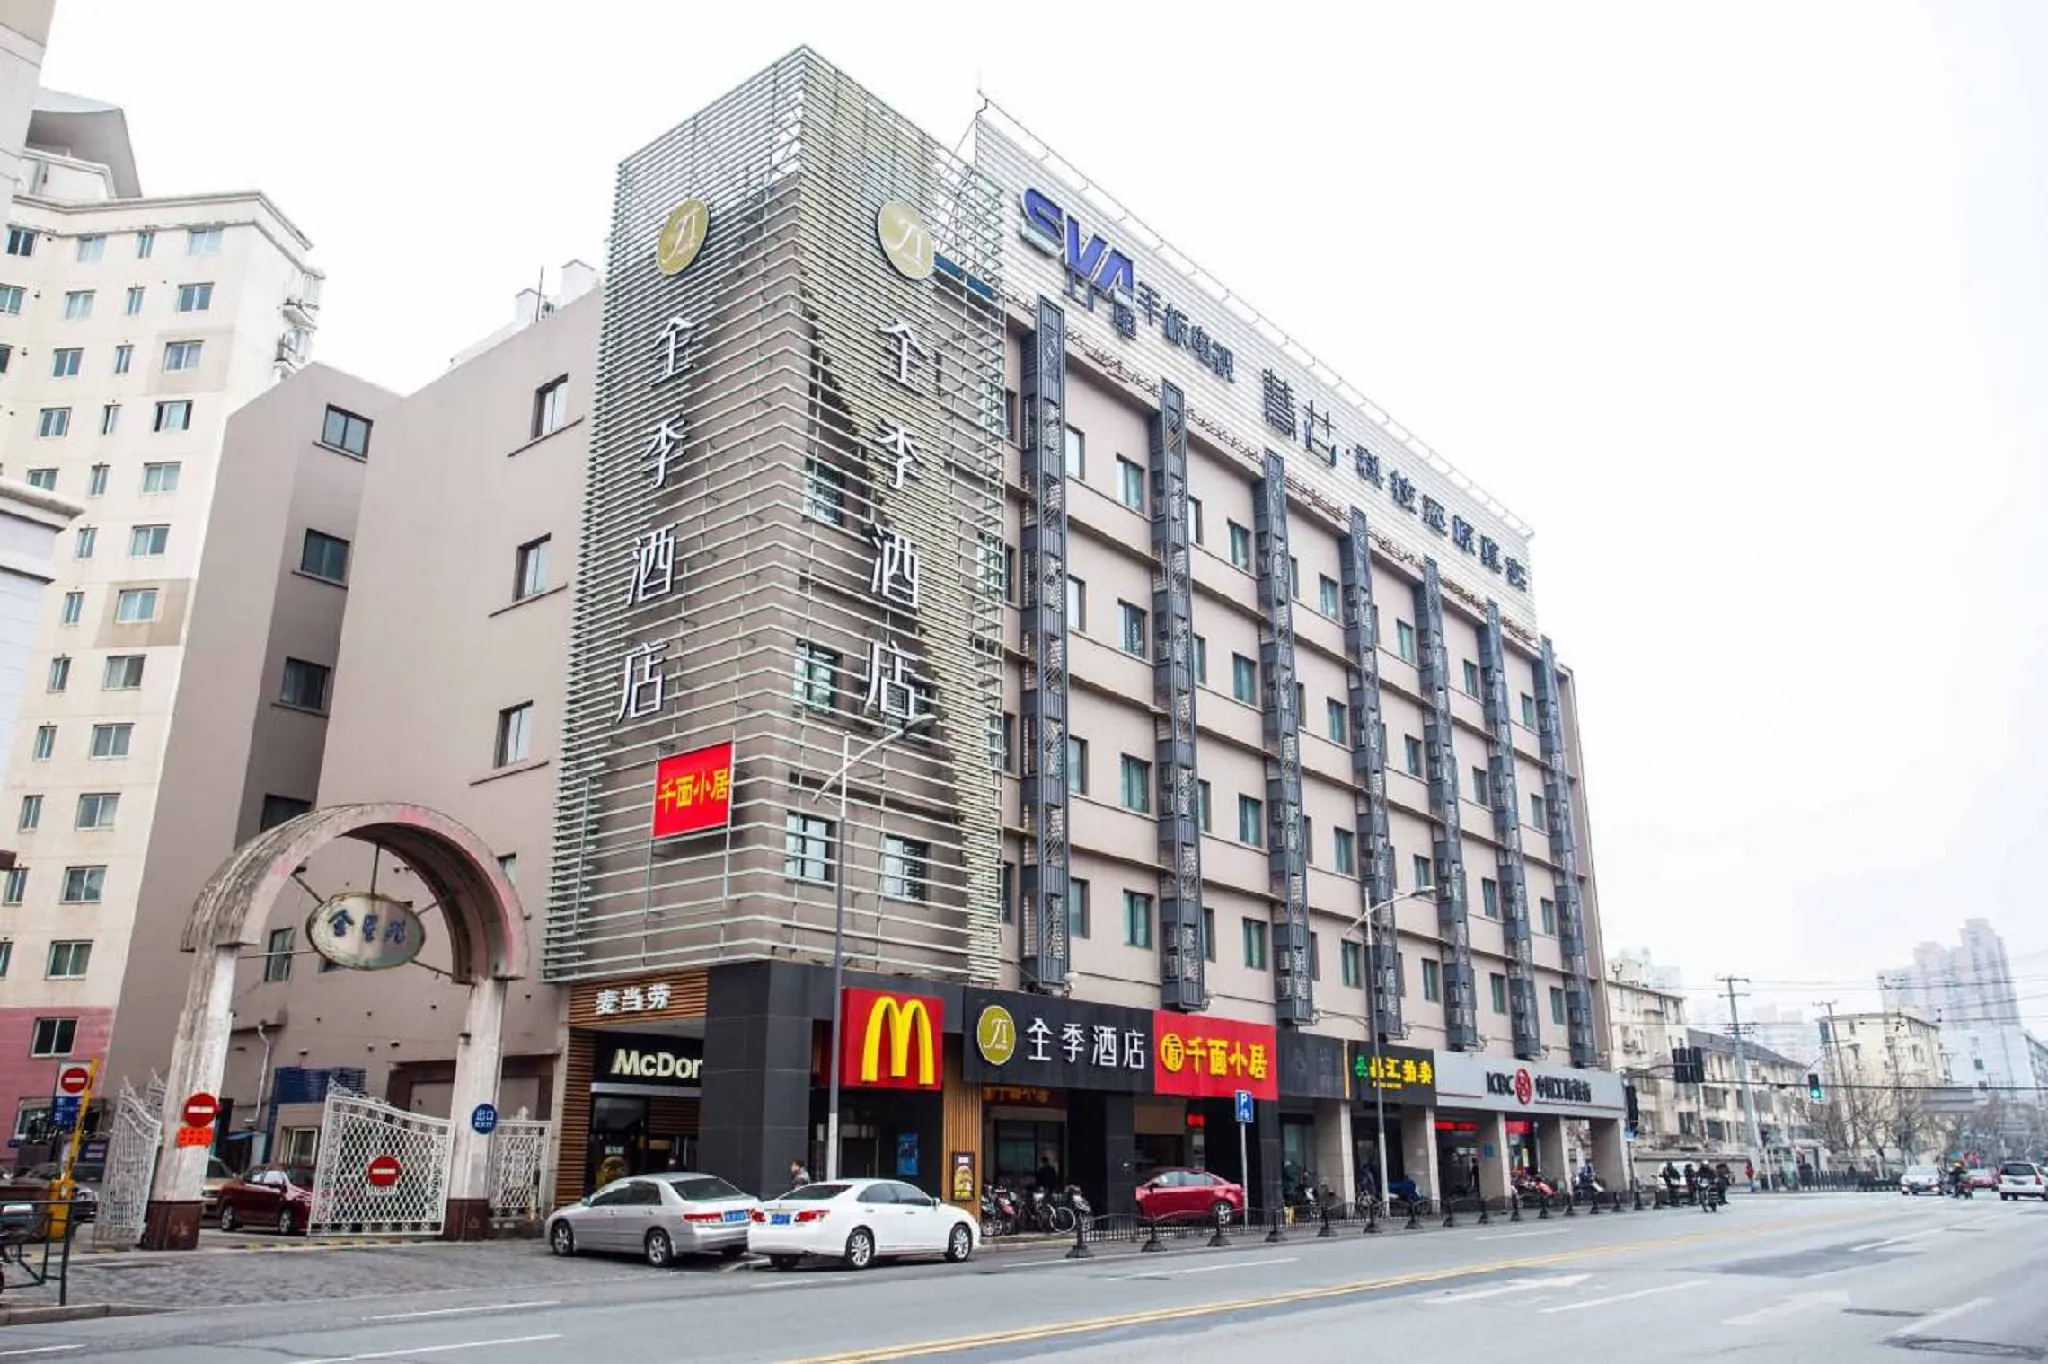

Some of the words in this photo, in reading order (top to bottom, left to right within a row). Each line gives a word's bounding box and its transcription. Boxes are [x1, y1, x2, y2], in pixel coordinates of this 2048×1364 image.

[1020, 188, 1134, 303] SVA
[1136, 281, 1235, 384] 平板电视
[614, 315, 697, 724] 全季酒店
[863, 317, 934, 721] 全季酒店
[658, 767, 729, 814] 千面小居
[596, 983, 671, 1015] 麦当劳
[1026, 1017, 1146, 1070] 全季酒店
[1186, 1036, 1268, 1079] 千面小居
